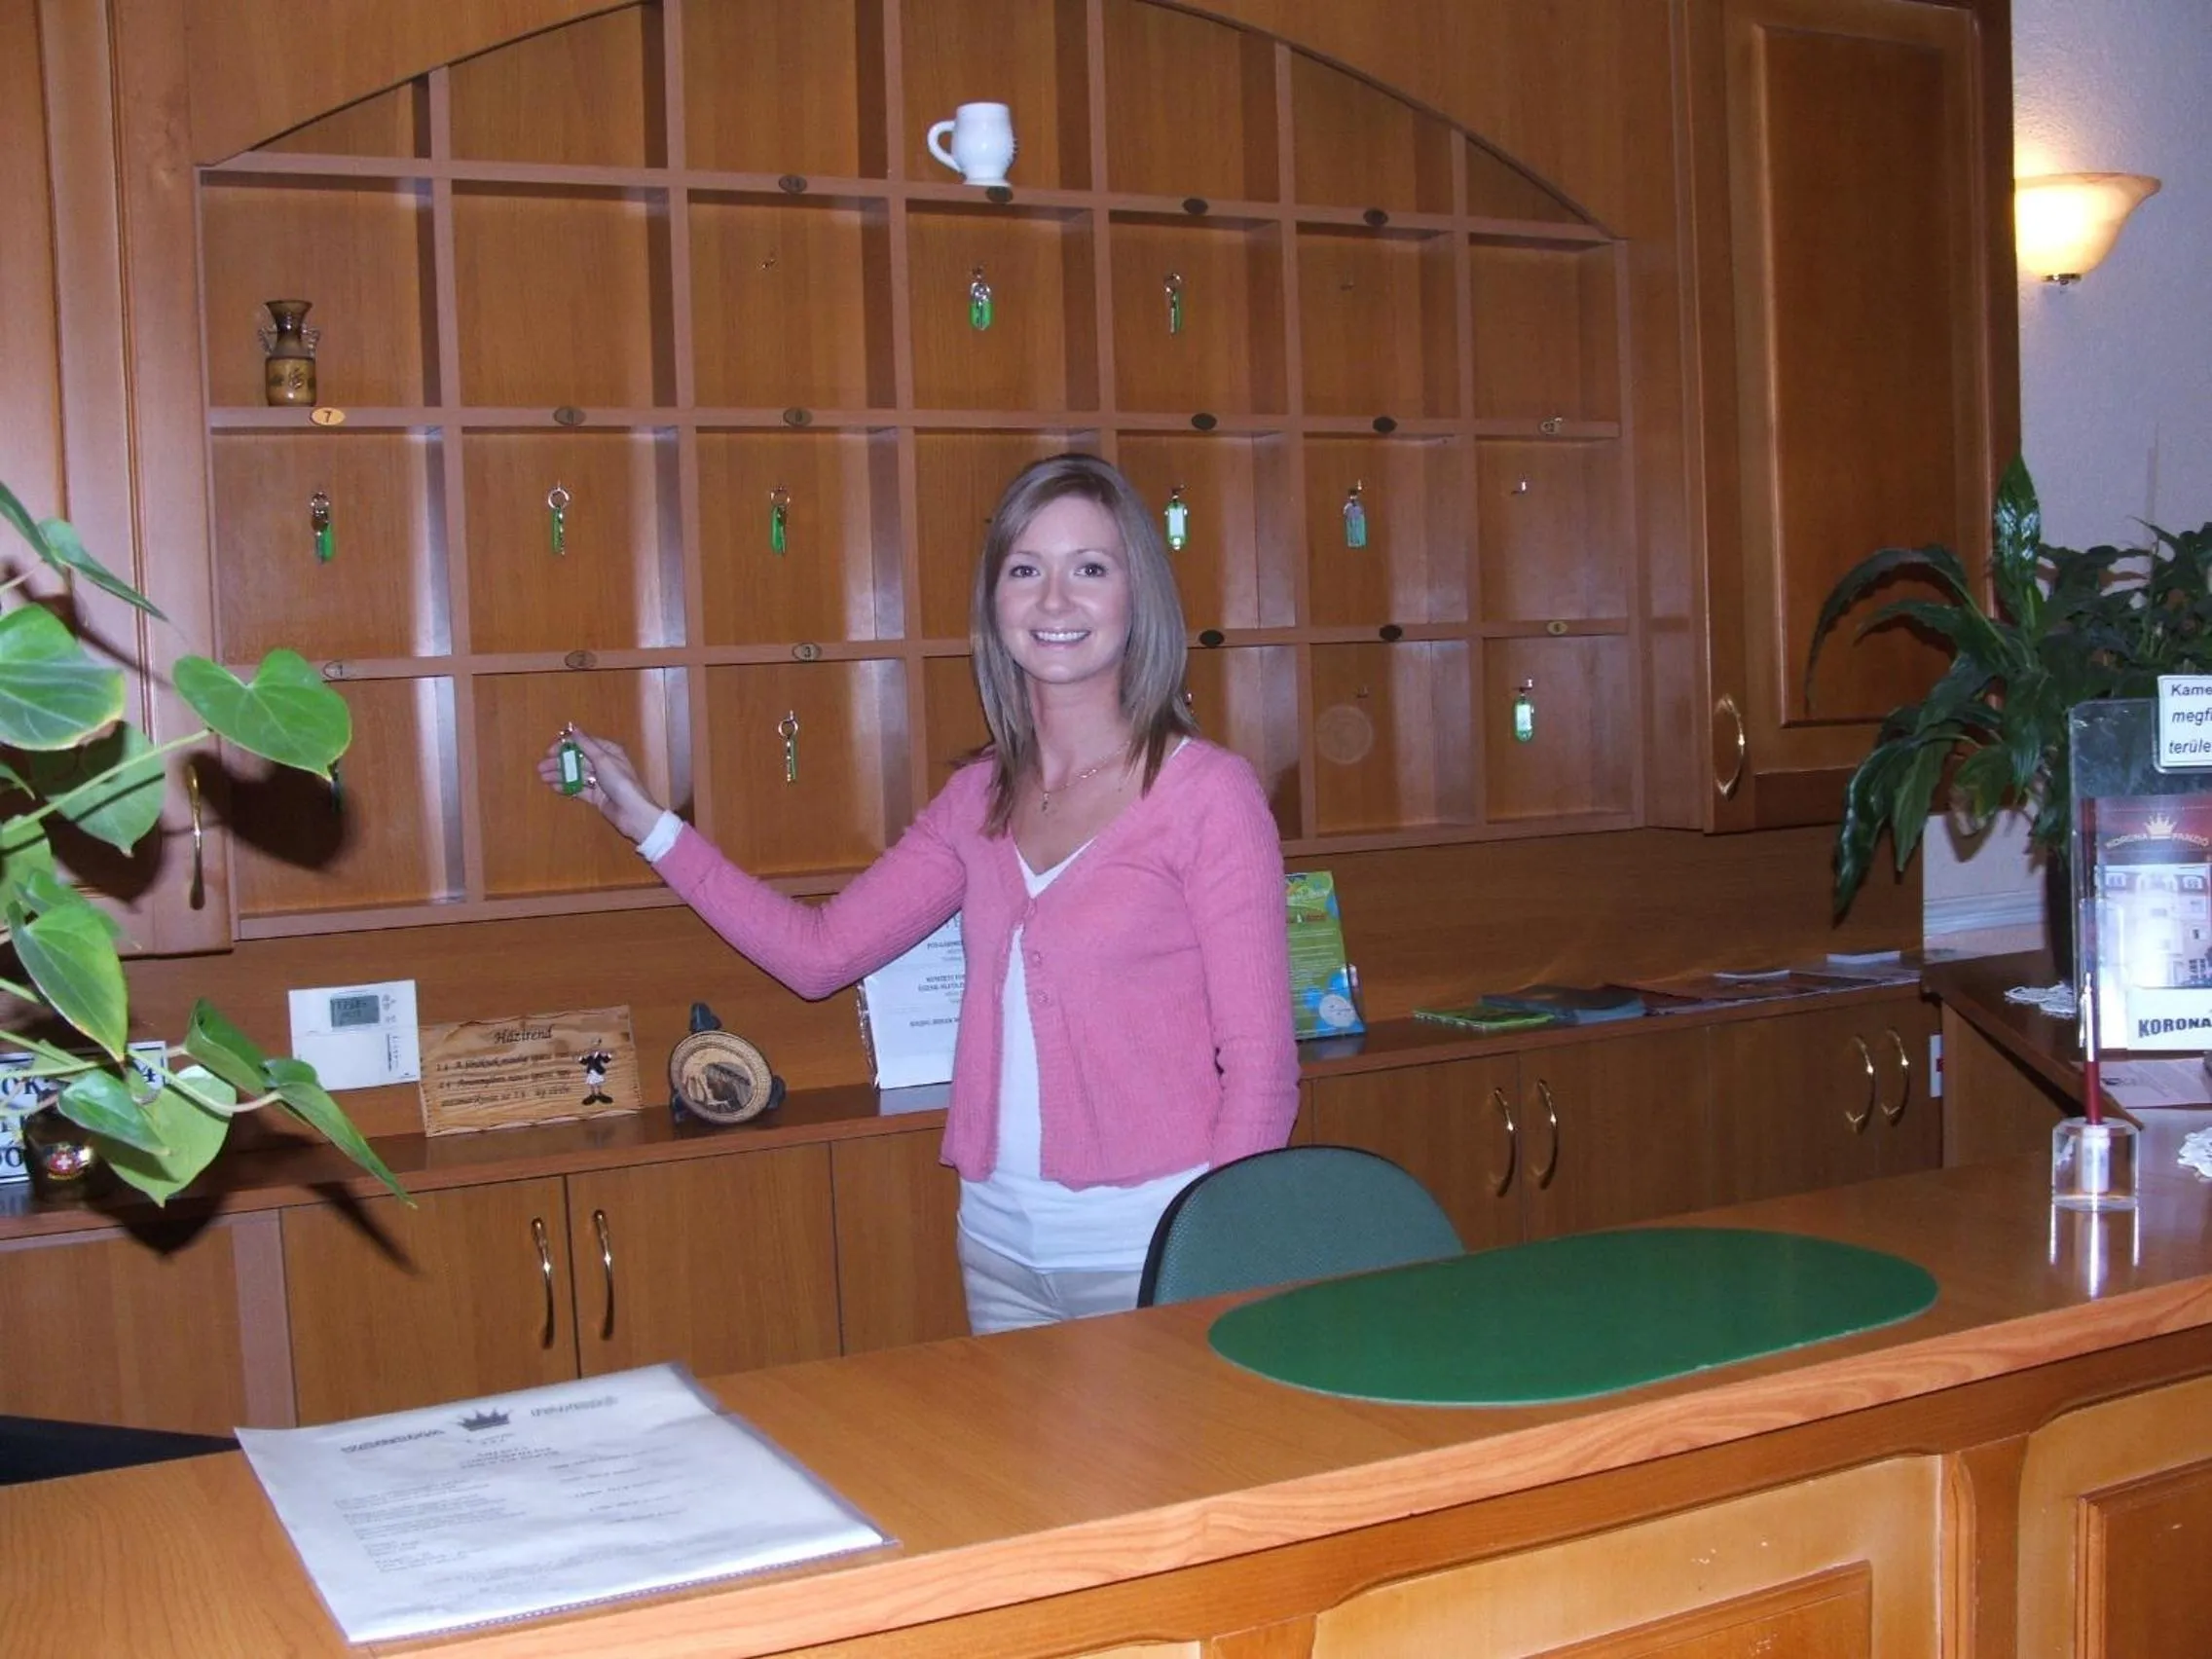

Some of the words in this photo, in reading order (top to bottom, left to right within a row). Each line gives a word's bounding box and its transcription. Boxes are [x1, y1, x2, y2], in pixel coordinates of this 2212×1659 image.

[322, 410, 332, 423] 7
[803, 645, 812, 658] 3
[2138, 1017, 2212, 1039] KORONA
